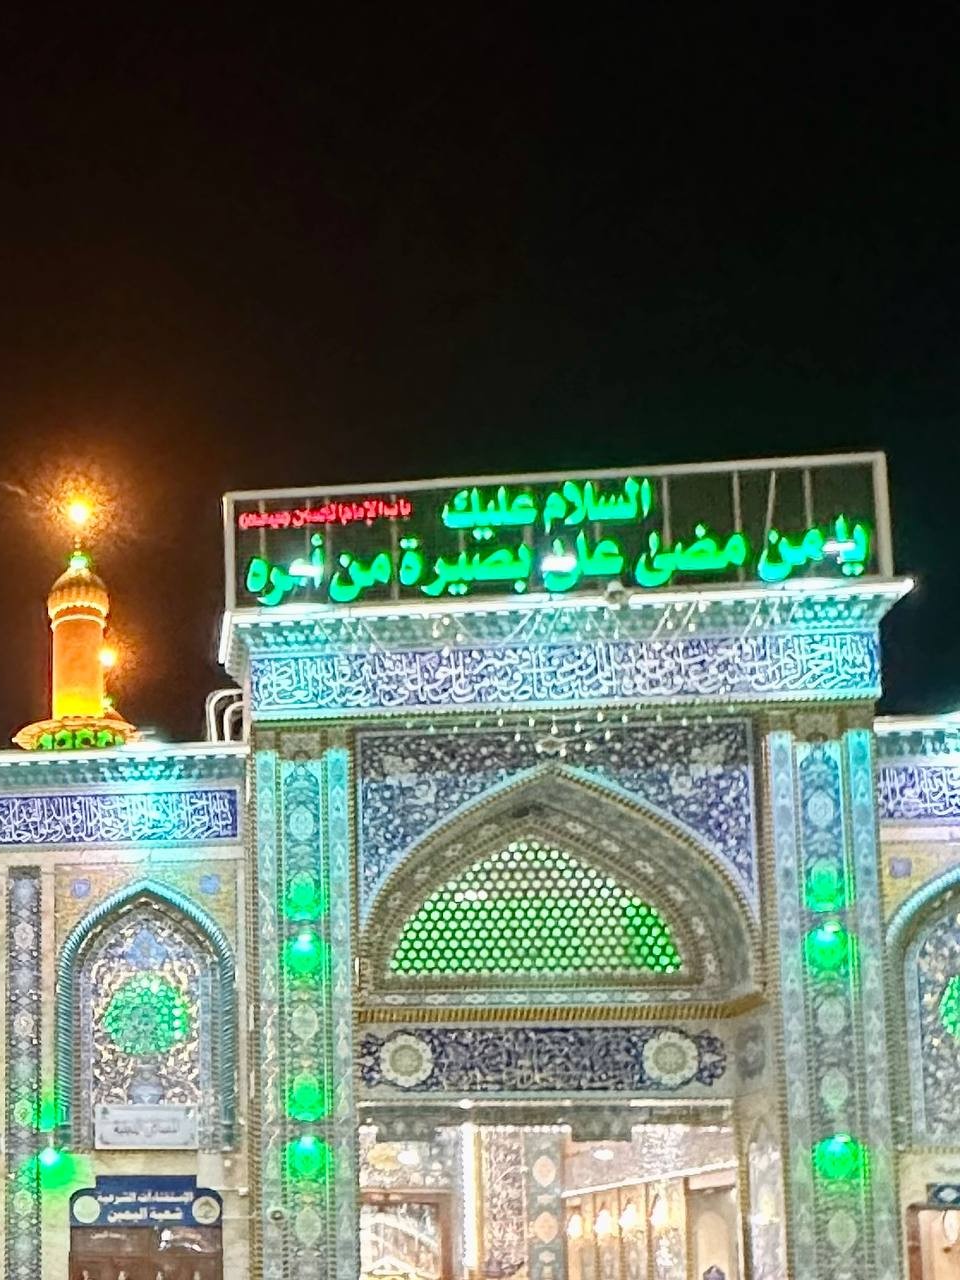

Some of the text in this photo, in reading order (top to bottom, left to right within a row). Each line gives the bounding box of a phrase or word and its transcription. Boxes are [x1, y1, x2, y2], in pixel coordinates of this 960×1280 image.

[441, 476, 652, 540] السلام عليك
[398, 536, 532, 597] بصيرة
[758, 528, 825, 583] من
[828, 513, 870, 577] يا
[329, 551, 391, 604] من
